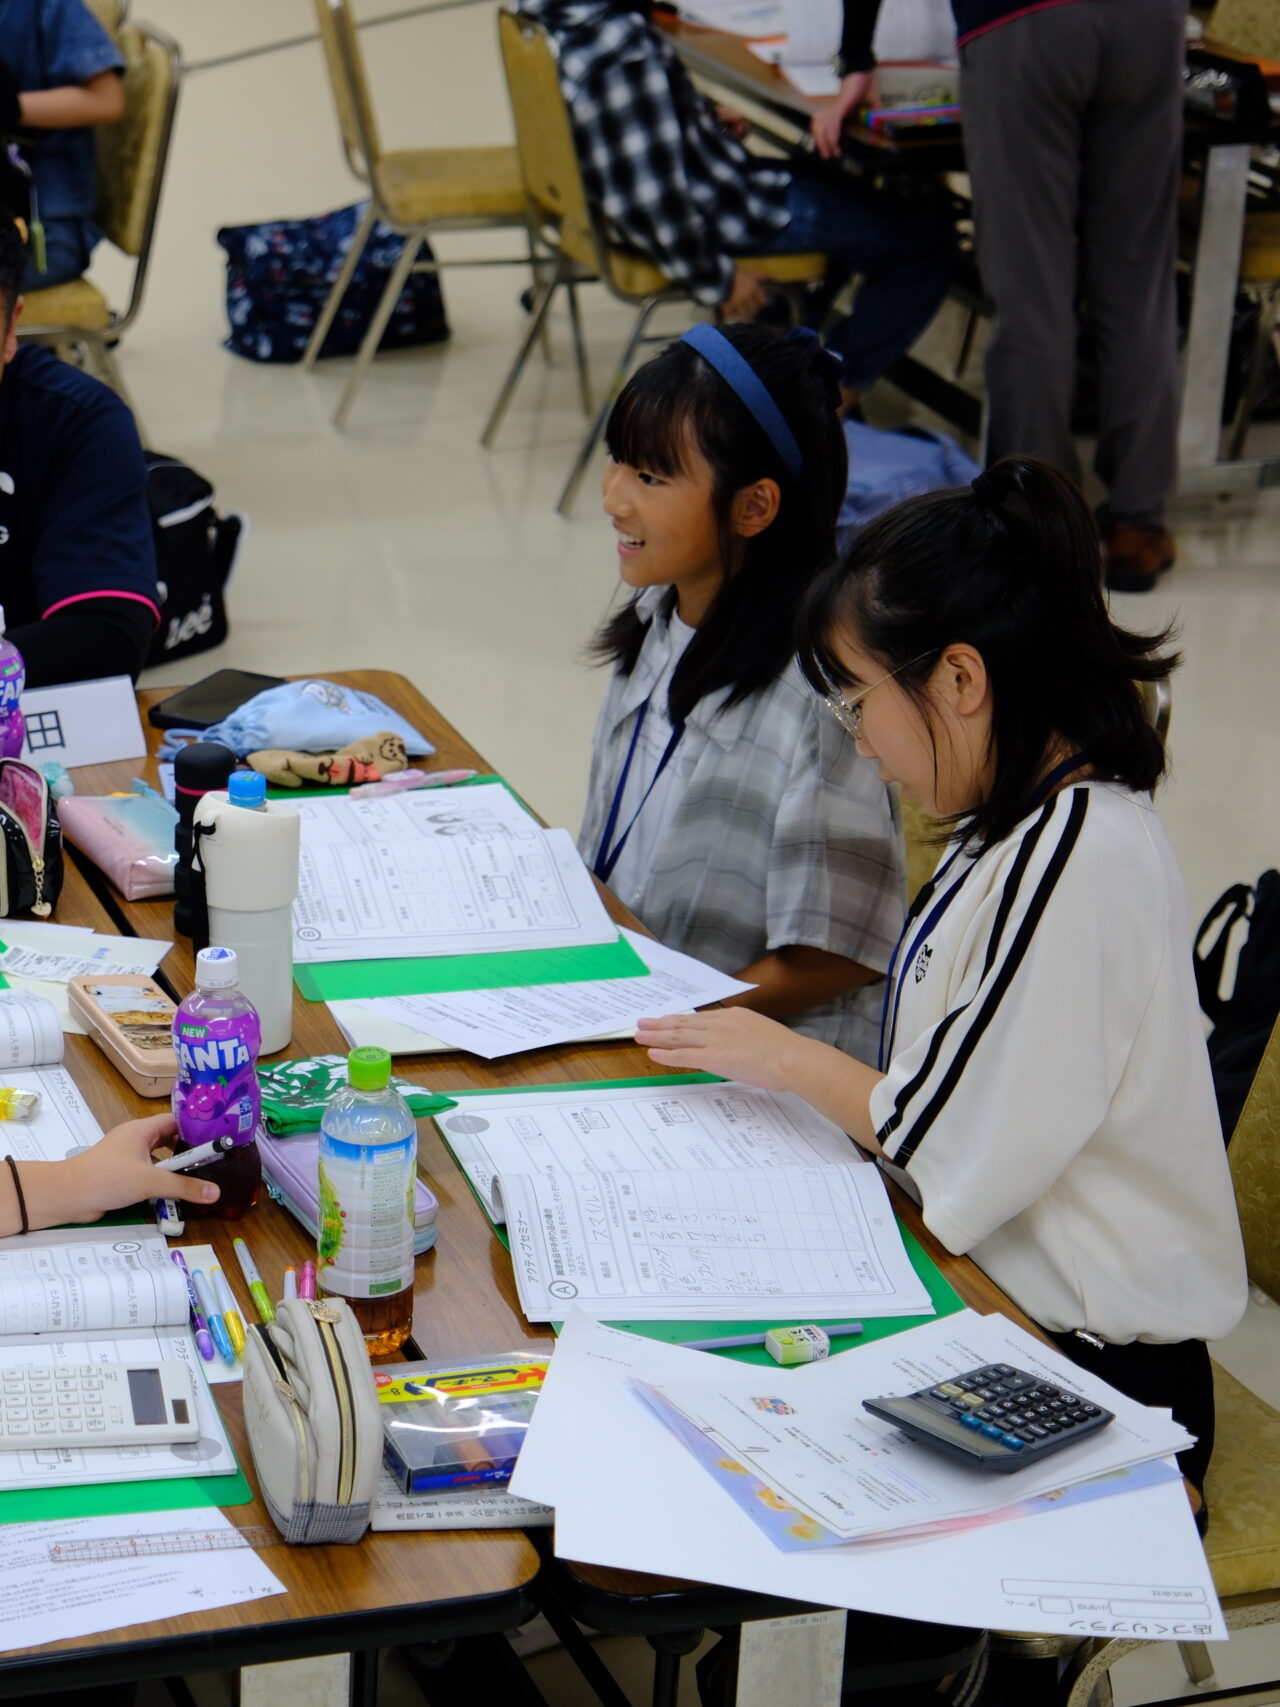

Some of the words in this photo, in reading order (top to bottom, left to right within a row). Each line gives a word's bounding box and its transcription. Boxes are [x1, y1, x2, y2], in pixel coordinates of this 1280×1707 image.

[25, 710, 66, 753] 田
[182, 1027, 206, 1038] NEW
[172, 1034, 250, 1072] FANTA
[51, 1071, 80, 1114] アクティブセミナー
[517, 1209, 538, 1283] アクティブセミナー
[1068, 1620, 1212, 1636] 店づくりプラン
